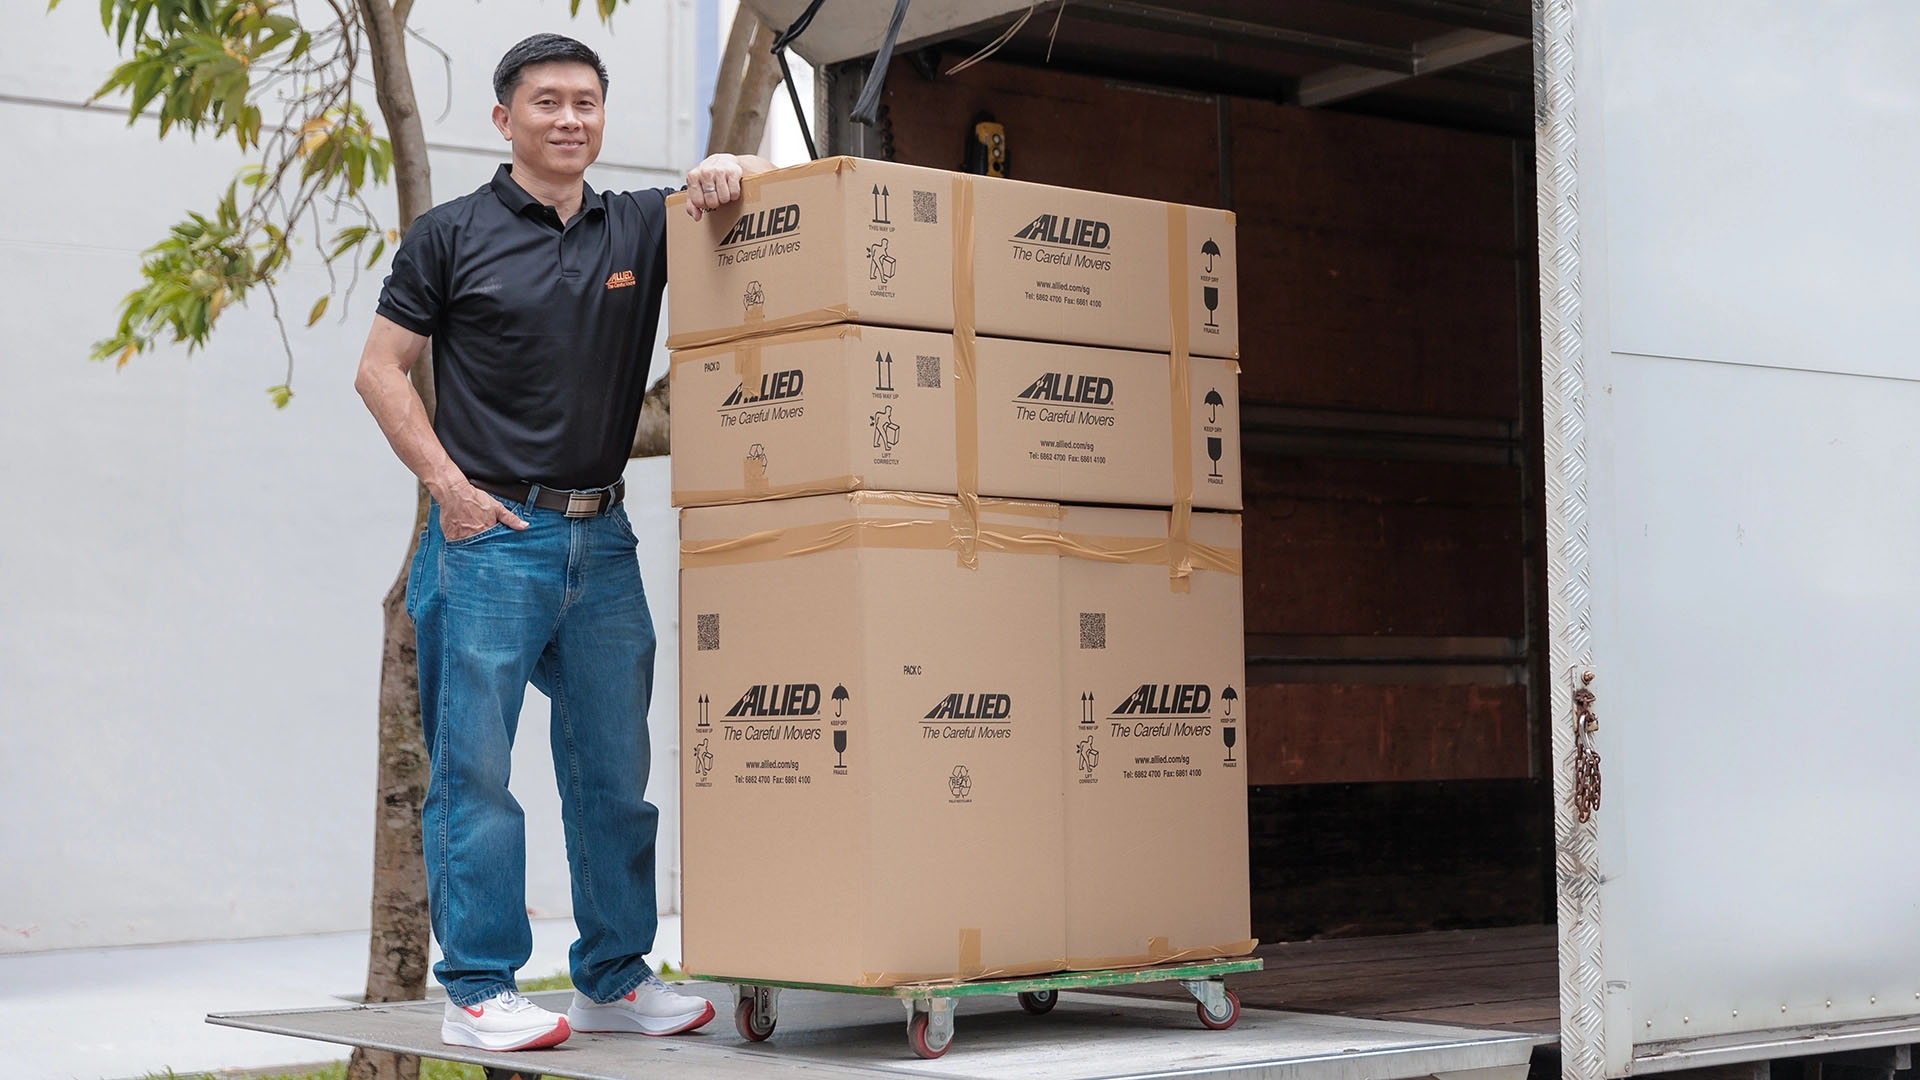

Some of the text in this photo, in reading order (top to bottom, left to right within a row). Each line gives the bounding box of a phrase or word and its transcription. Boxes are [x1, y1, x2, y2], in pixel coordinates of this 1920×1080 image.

[717, 204, 800, 246] ALLIED
[1014, 214, 1110, 249] ALLIED
[718, 241, 801, 267] The Careful Movers
[1012, 246, 1111, 271] The Careful Movers
[605, 270, 635, 285] ALLIED
[1036, 281, 1090, 295] www.allied.com/sg
[1025, 292, 1102, 308] Tel: 6862 4700 Fax: 6861 4100
[704, 362, 716, 372] PACK
[1017, 372, 1114, 405] ALLIED
[721, 406, 804, 427] The Careful Movers
[1016, 406, 1115, 426] The Careful Movers
[1040, 440, 1095, 452] www.allied.com/sg
[1029, 452, 1039, 460] Tel:
[1040, 453, 1052, 461] 6862
[1080, 455, 1092, 463] 6861
[1093, 456, 1106, 464] 4100
[904, 665, 922, 675] PACK C
[725, 684, 821, 716] ALLIED
[924, 694, 1011, 719] ALLIED
[1112, 684, 1211, 714] ALLIED
[724, 725, 821, 740] The Careful Movers
[922, 726, 1011, 738] The Careful Movers
[1111, 722, 1211, 737] The Careful Movers
[746, 760, 799, 771] www.allied.com/sg
[1135, 755, 1190, 765] www.allied.com/sg
[745, 776, 757, 784] 6862
[758, 776, 770, 784] 4700
[772, 776, 784, 784] Fax:
[785, 776, 797, 784] 6861
[798, 776, 811, 784] 4100
[1134, 770, 1147, 778] 6862
[1148, 770, 1160, 778] 4700
